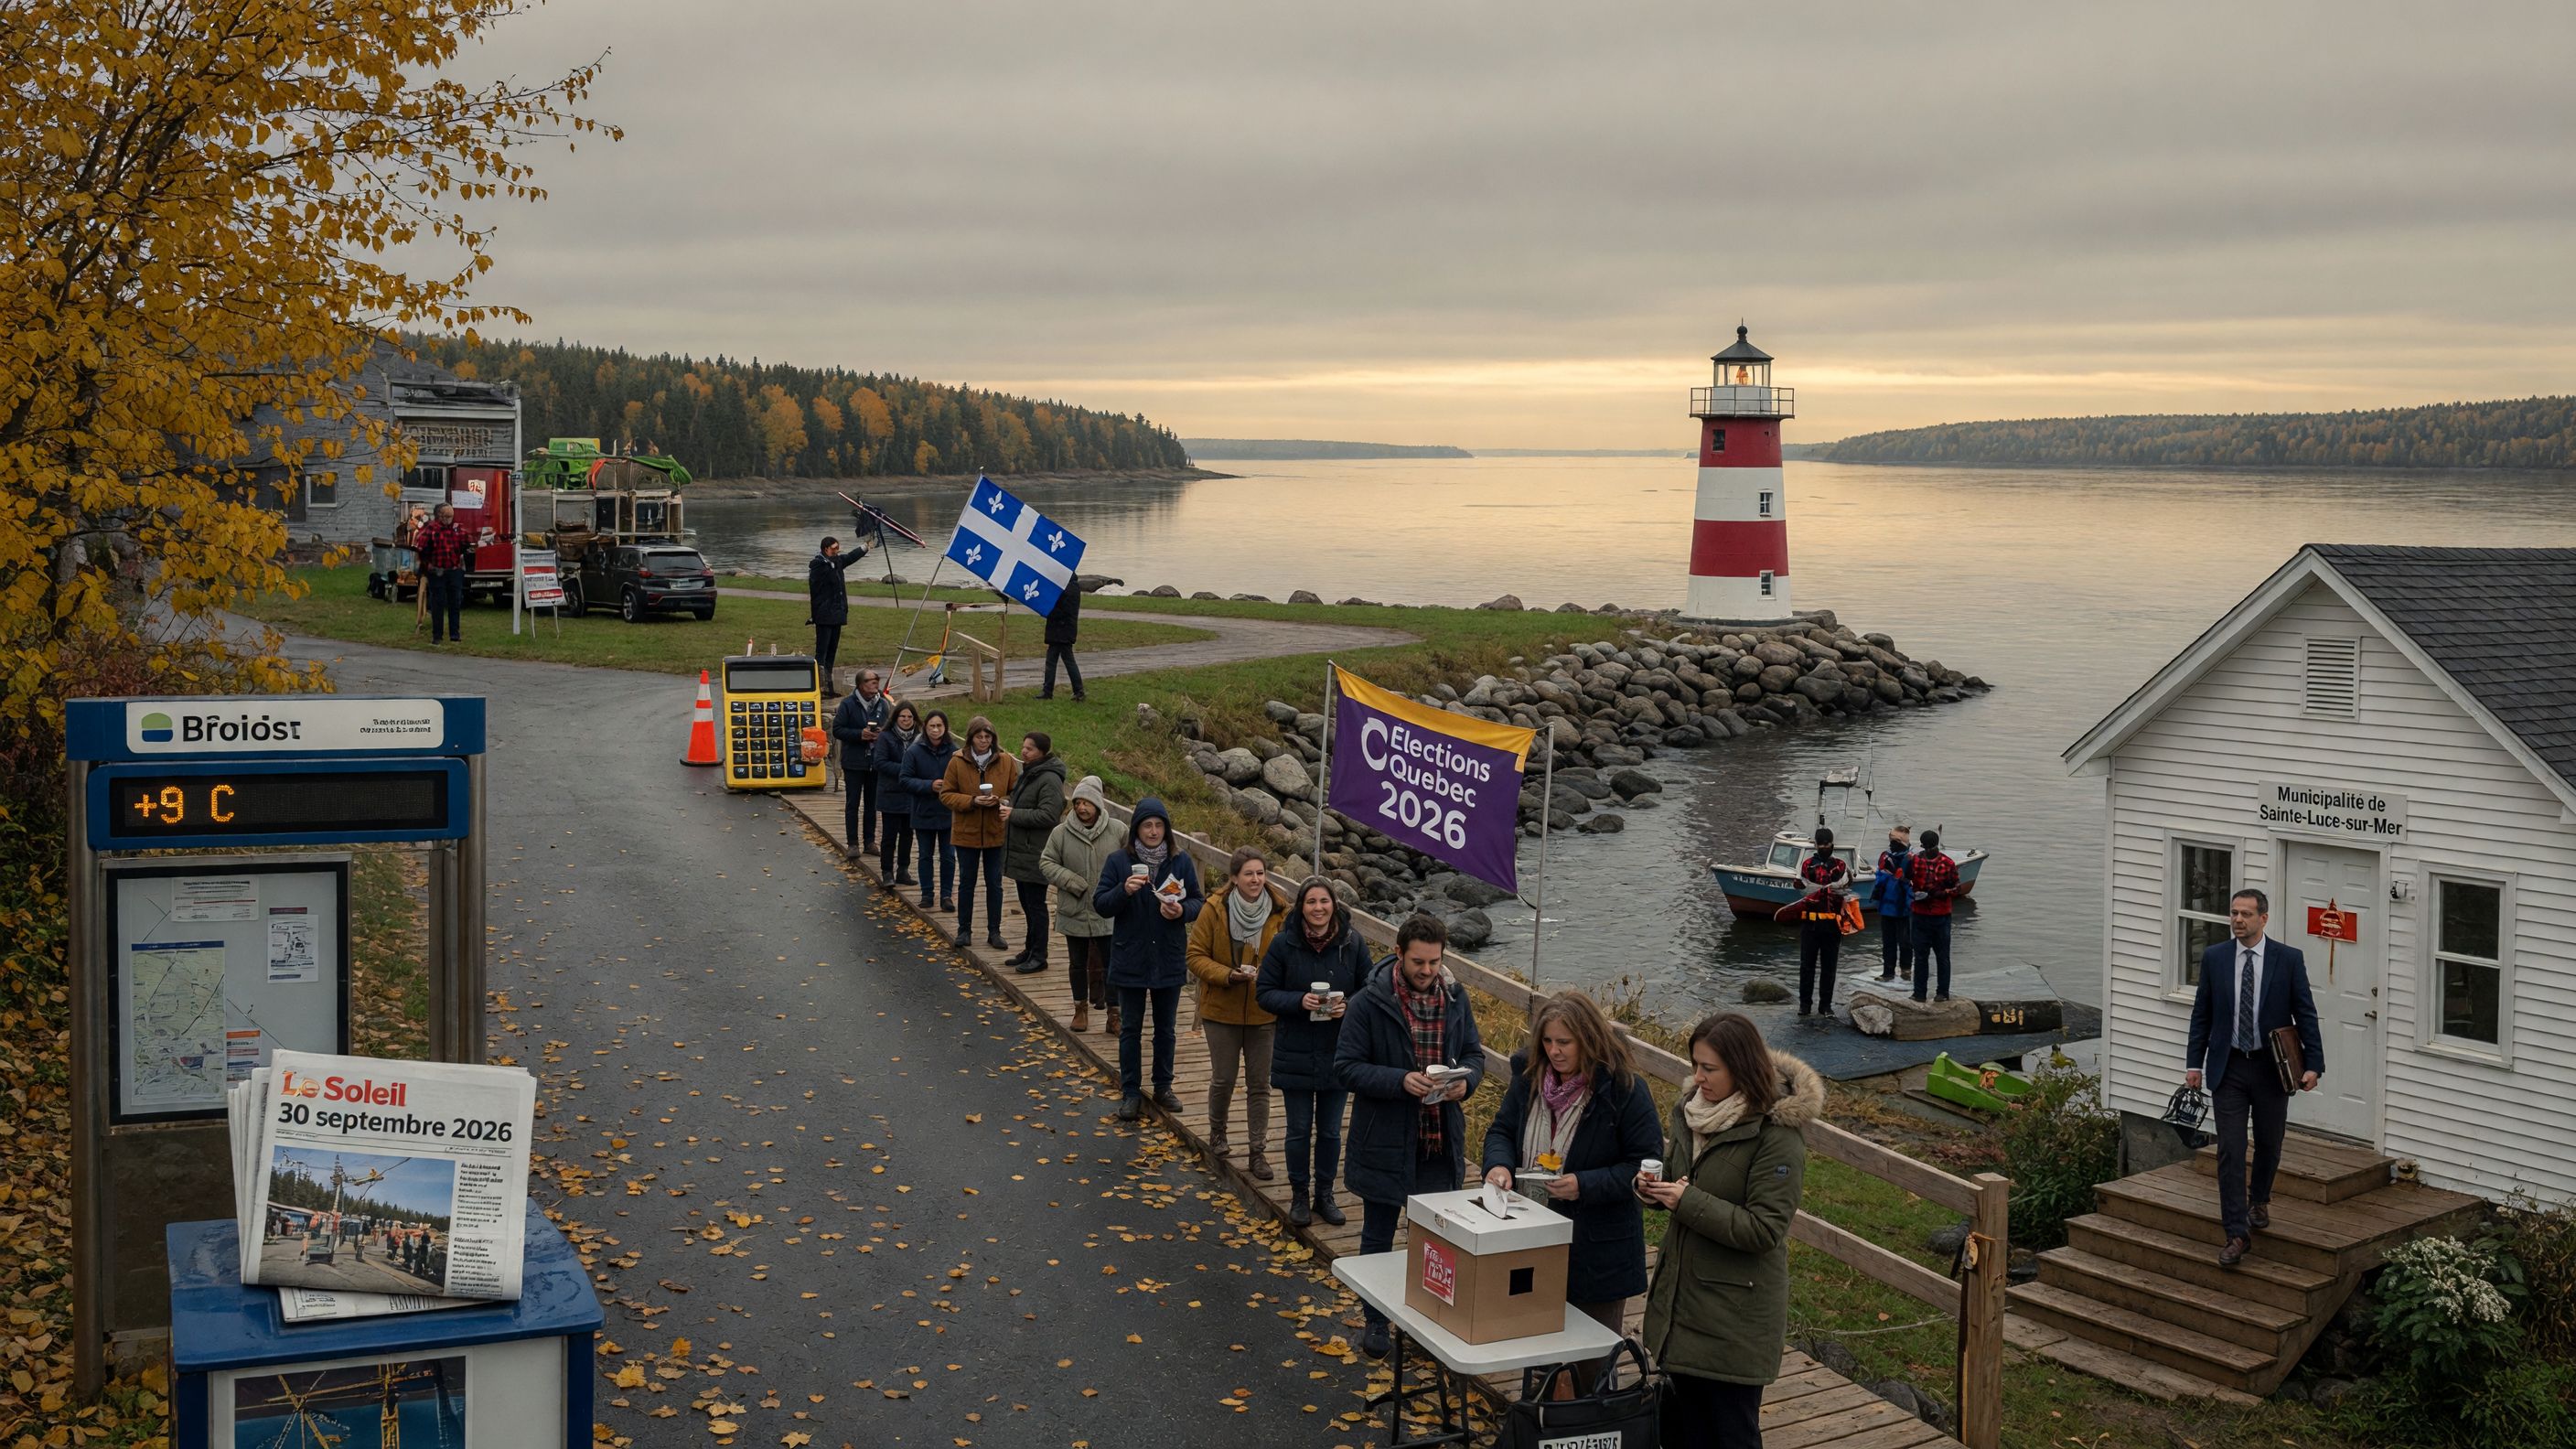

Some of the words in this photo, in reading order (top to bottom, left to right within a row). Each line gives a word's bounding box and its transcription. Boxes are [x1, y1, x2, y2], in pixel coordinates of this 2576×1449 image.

[1390, 755, 1476, 808] Quebec
[2278, 786, 2365, 810] Municipalité
[2368, 796, 2386, 812] de
[134, 786, 183, 823] +9
[211, 785, 235, 822] C
[1379, 781, 1467, 850] 2026
[2259, 804, 2403, 835] Sainte-Luce-sur-Mer
[324, 1076, 407, 1108] Soleil
[277, 1102, 310, 1125] 30
[316, 1111, 445, 1137] septembre
[451, 1118, 512, 1143] 2026
